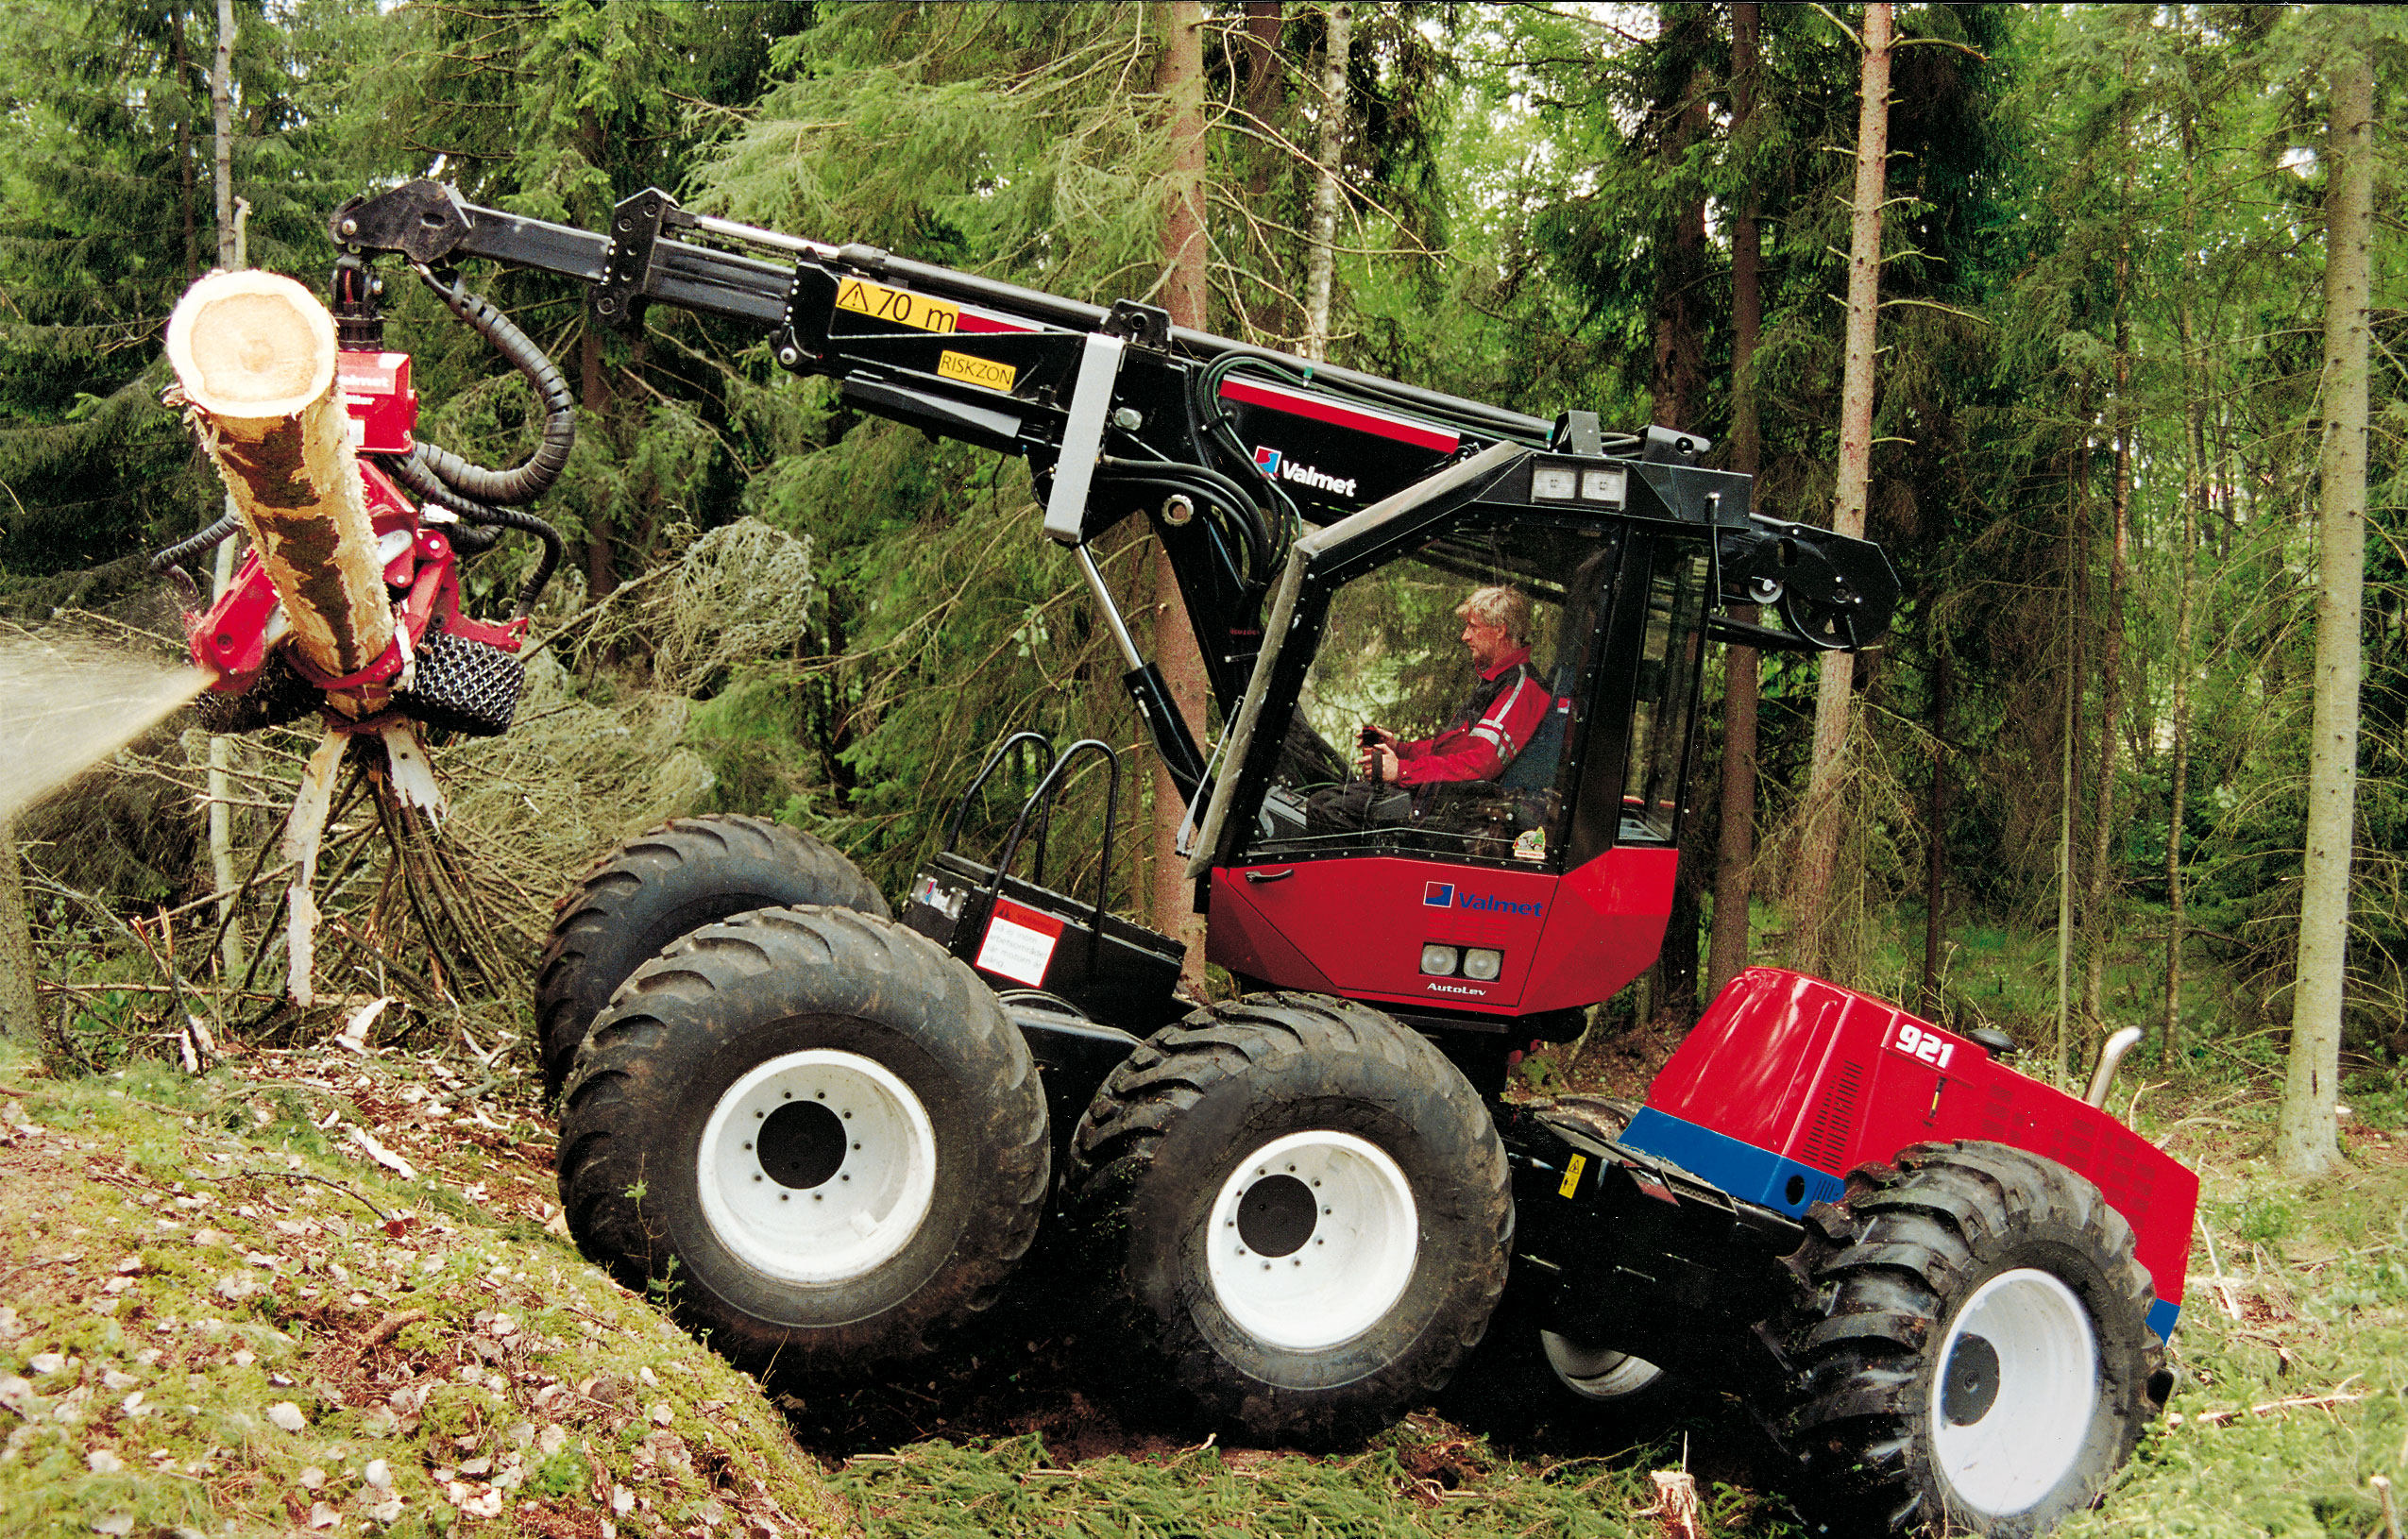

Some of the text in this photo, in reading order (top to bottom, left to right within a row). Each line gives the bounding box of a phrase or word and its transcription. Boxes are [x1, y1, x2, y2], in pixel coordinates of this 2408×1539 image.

[876, 288, 955, 332] 70 m
[940, 355, 1013, 385] RISKZON
[1281, 460, 1357, 498] Valmet
[1458, 892, 1544, 917] Valmet
[1427, 982, 1486, 996] AutoLev
[1895, 1023, 1955, 1069] 921
